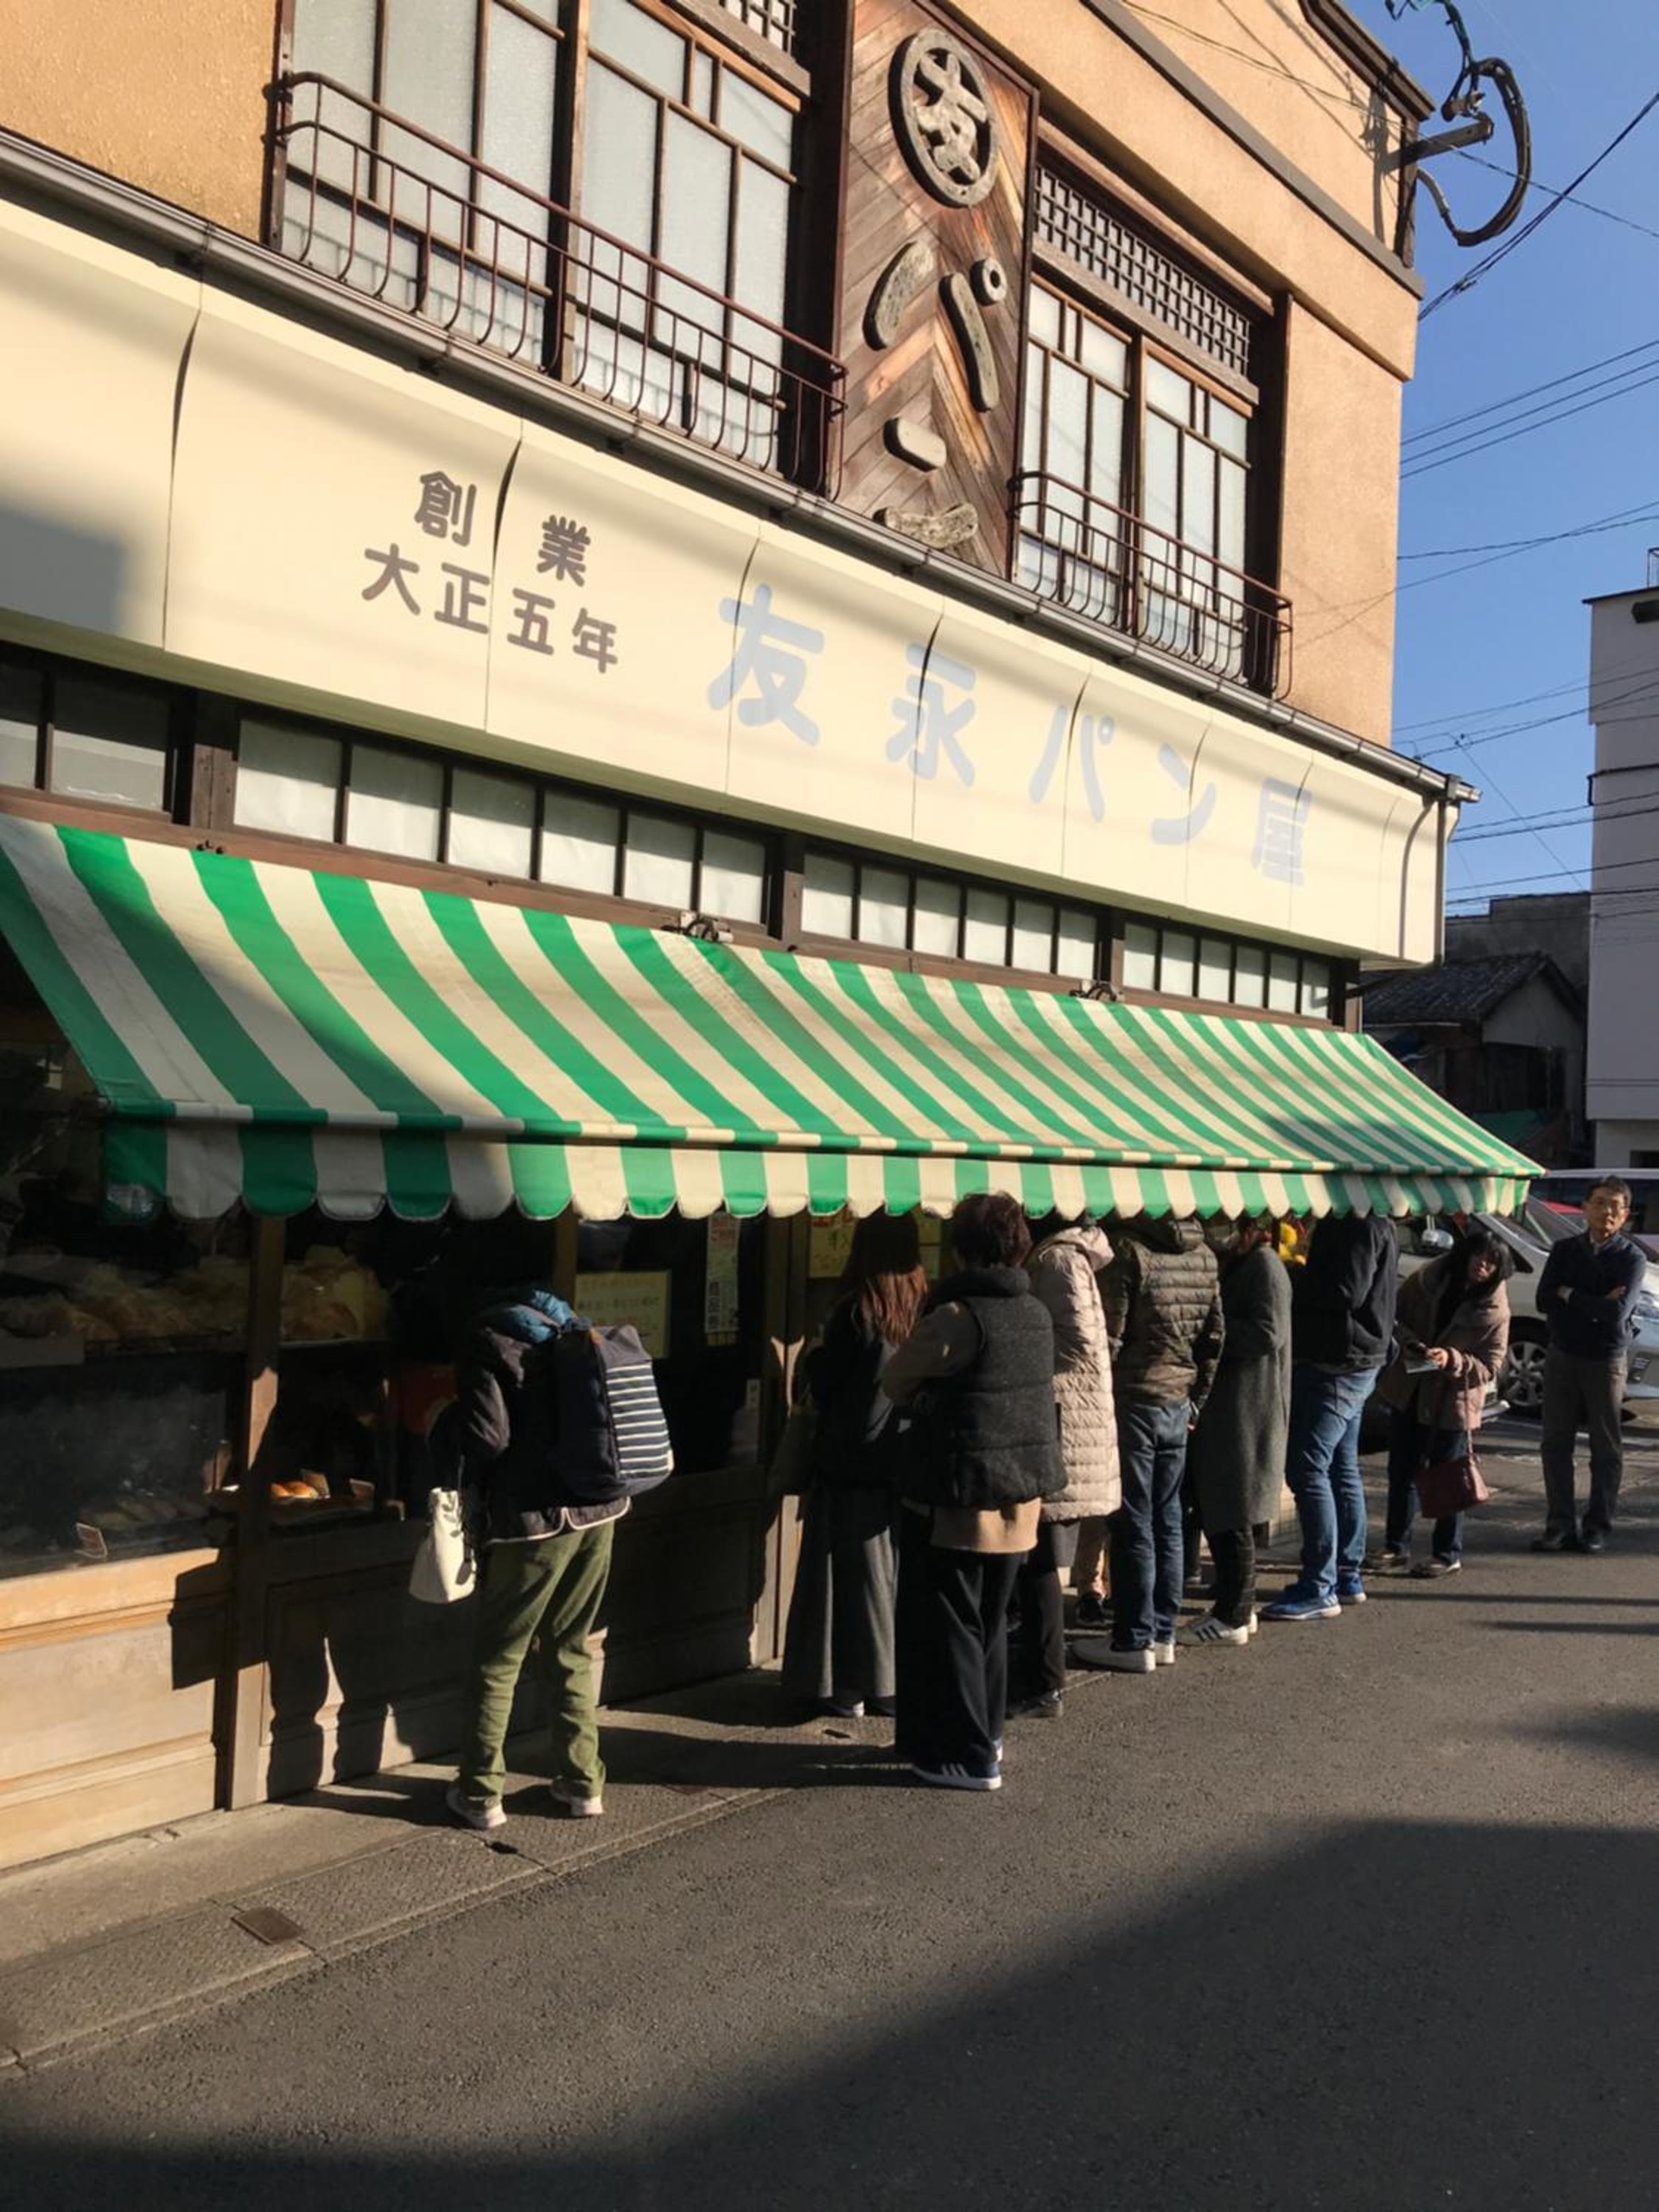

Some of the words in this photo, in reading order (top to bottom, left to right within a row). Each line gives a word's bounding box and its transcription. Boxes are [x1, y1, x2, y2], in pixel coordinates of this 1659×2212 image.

[862, 239, 1007, 551] パン
[361, 543, 618, 674] 大正五年
[414, 471, 591, 587] 創業
[708, 583, 1313, 886] 友永パン屋
